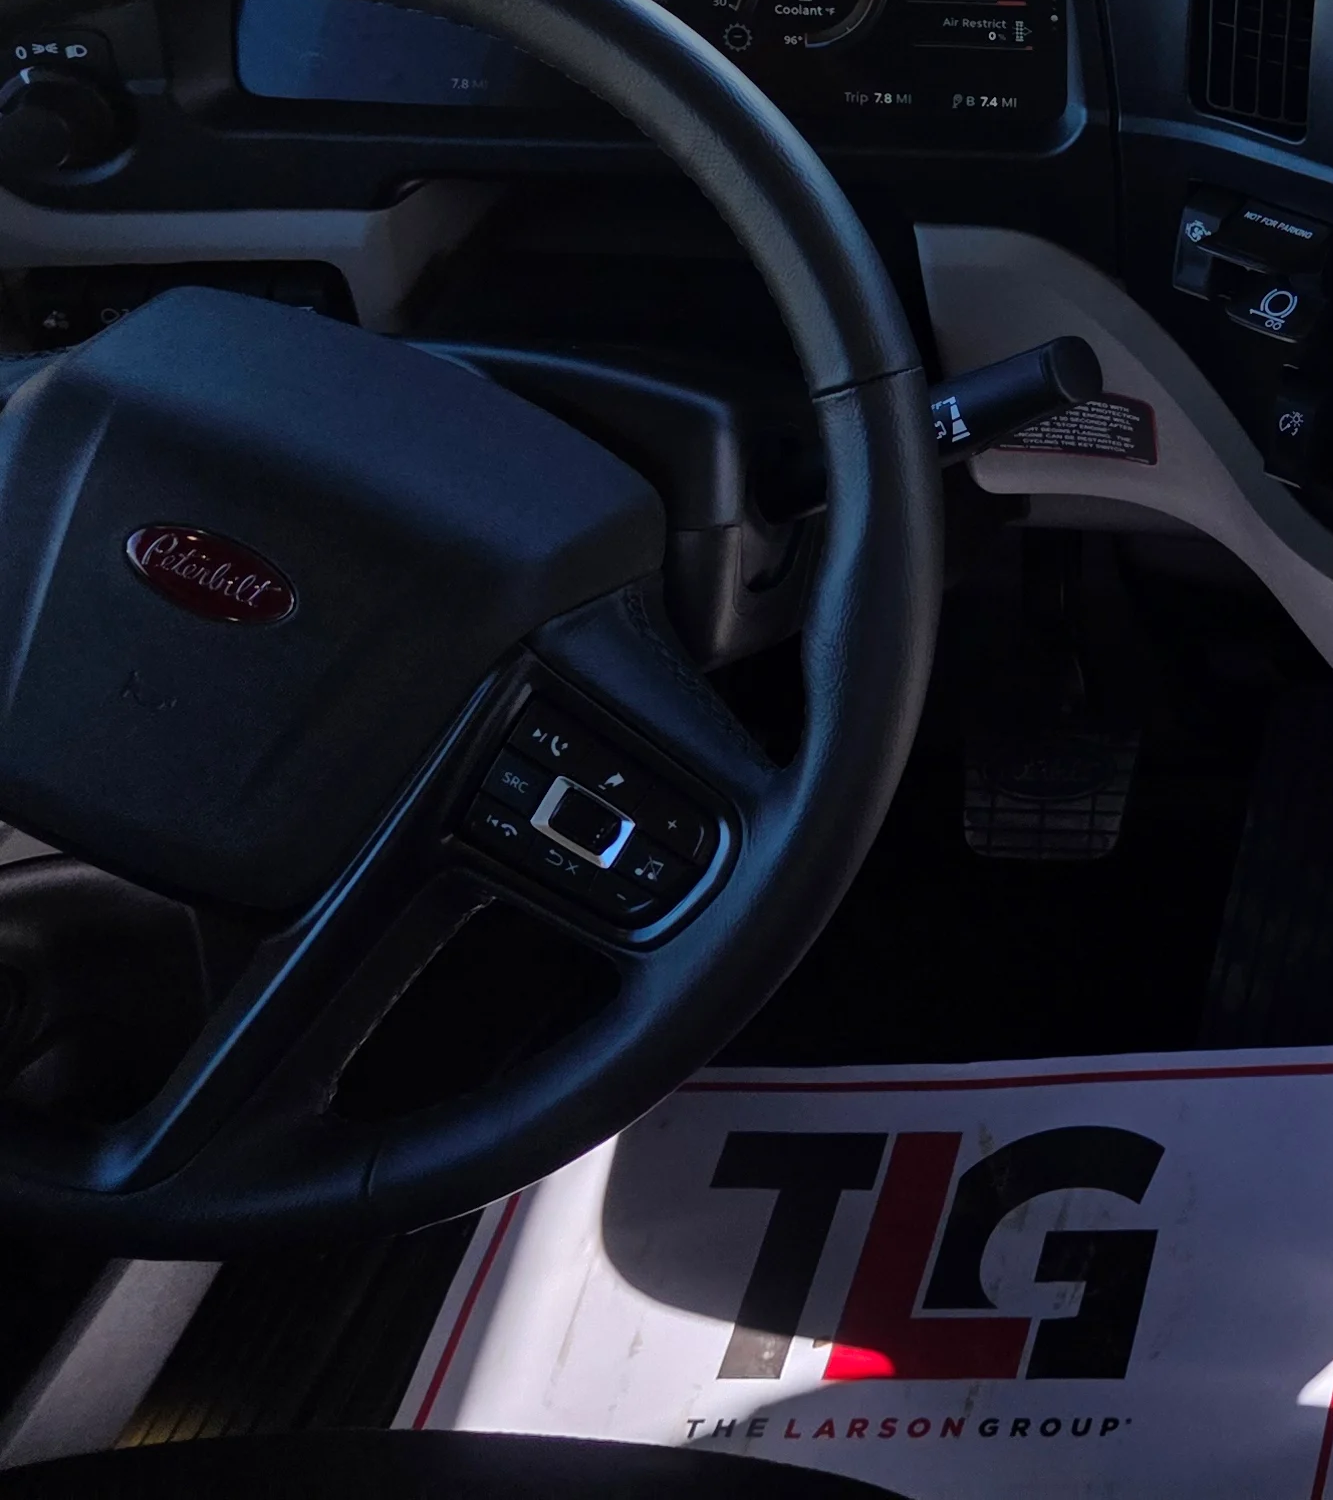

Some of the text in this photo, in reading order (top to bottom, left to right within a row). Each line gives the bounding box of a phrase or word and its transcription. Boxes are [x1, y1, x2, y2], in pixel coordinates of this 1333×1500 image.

[774, 4, 823, 17] Coolant
[943, 17, 1007, 30] Air Restrict
[988, 31, 997, 42] 0
[450, 78, 470, 90] 7.8
[844, 91, 913, 106] Trip 7.8 MI
[966, 95, 1018, 108] B 7.4 MI
[1244, 210, 1314, 240] NOT FOR PARKING
[141, 533, 281, 607] Peterbilt
[502, 771, 529, 794] SRC
[709, 1124, 1165, 1381] TLG
[686, 1417, 1122, 1440] THE LARSON GROUP
